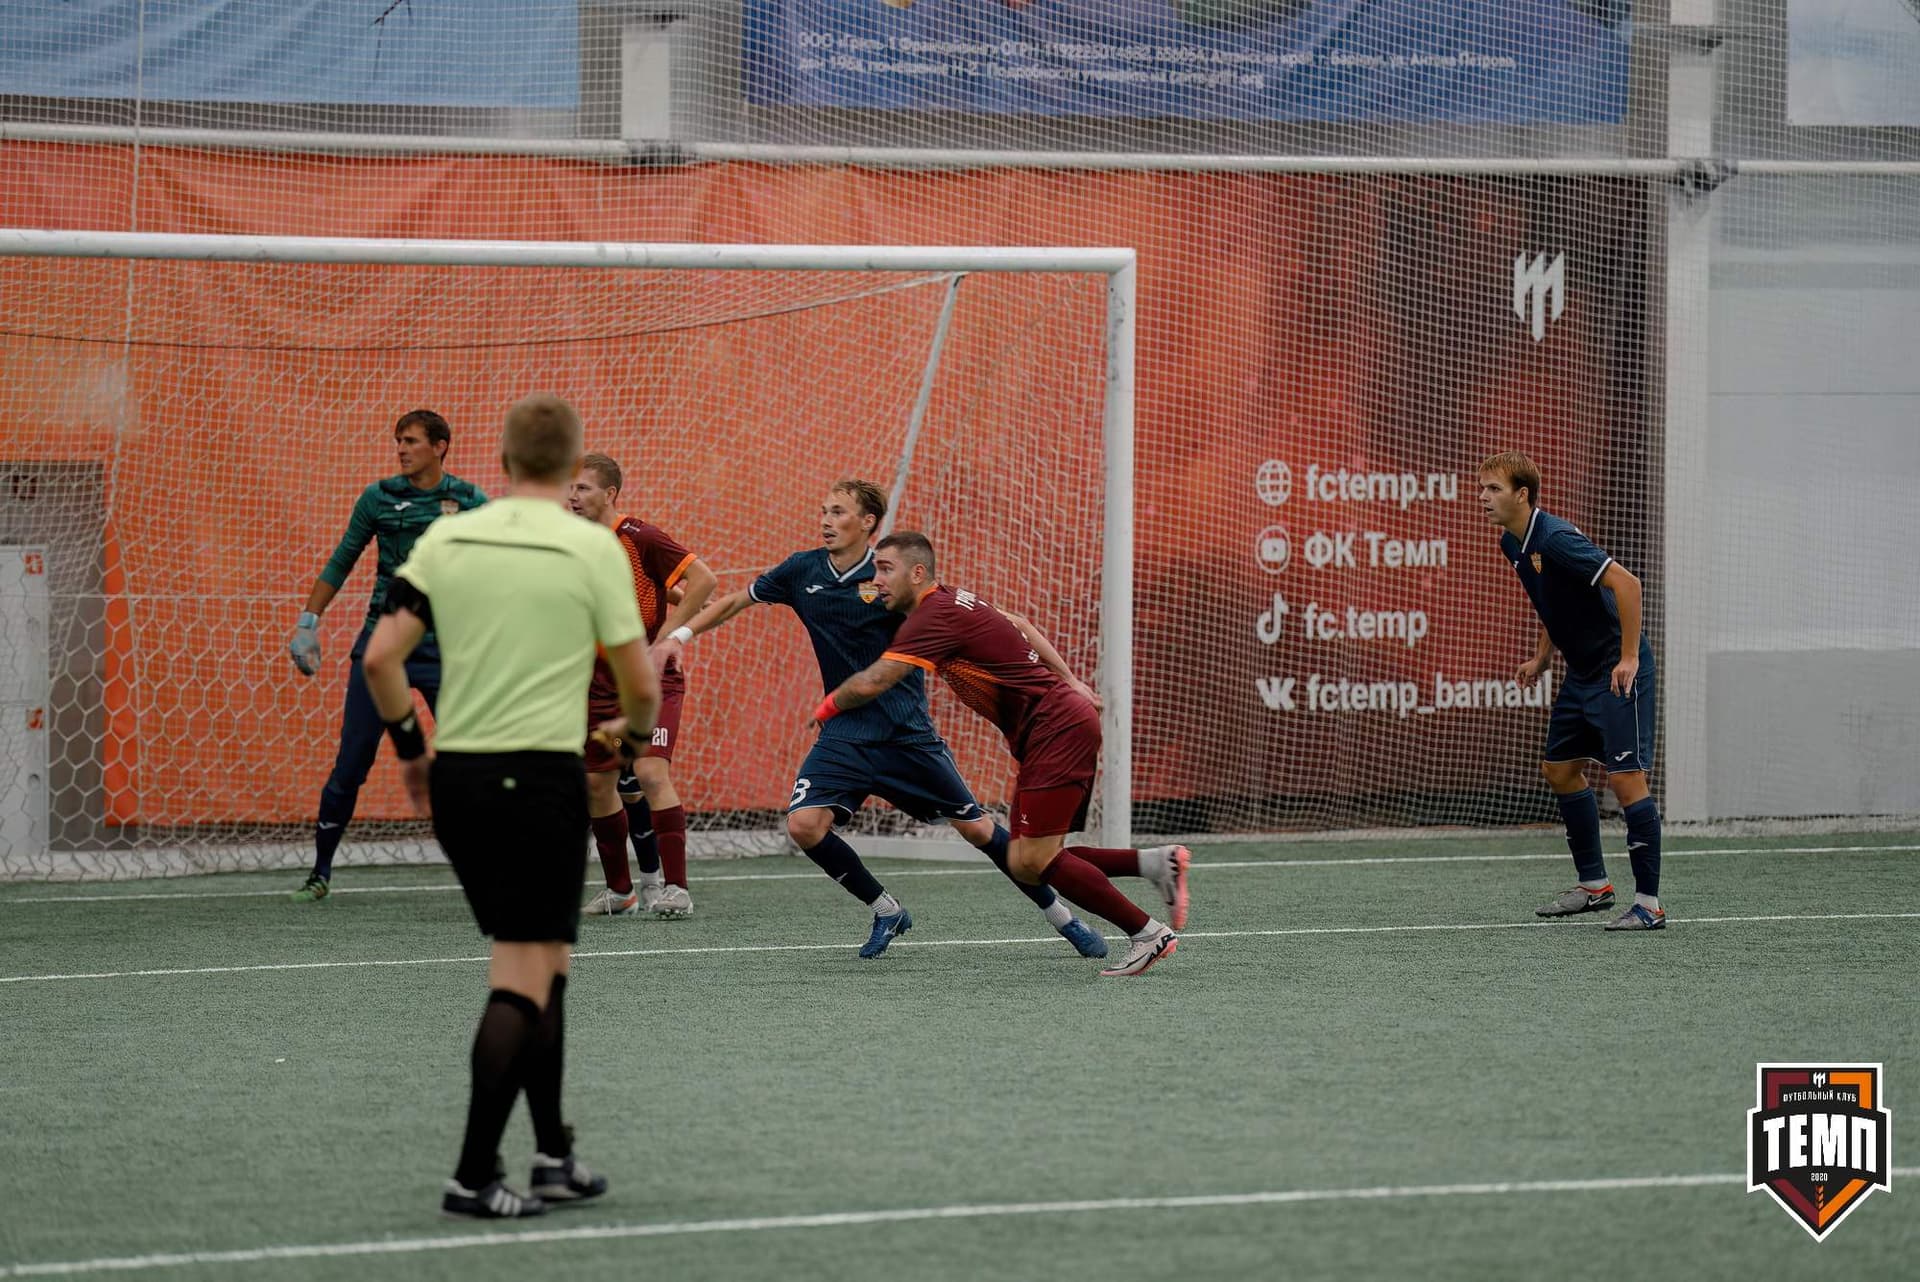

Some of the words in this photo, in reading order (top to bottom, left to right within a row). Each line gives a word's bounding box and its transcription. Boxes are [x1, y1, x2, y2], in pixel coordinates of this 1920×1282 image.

[1306, 463, 1457, 510] fctemp.ru
[1304, 531, 1356, 568] ФК
[1364, 532, 1447, 568] Темп
[1304, 602, 1427, 647] fc.temp
[1307, 669, 1552, 718] fctemp_barnaul
[651, 727, 668, 747] 20
[790, 778, 811, 807] 3
